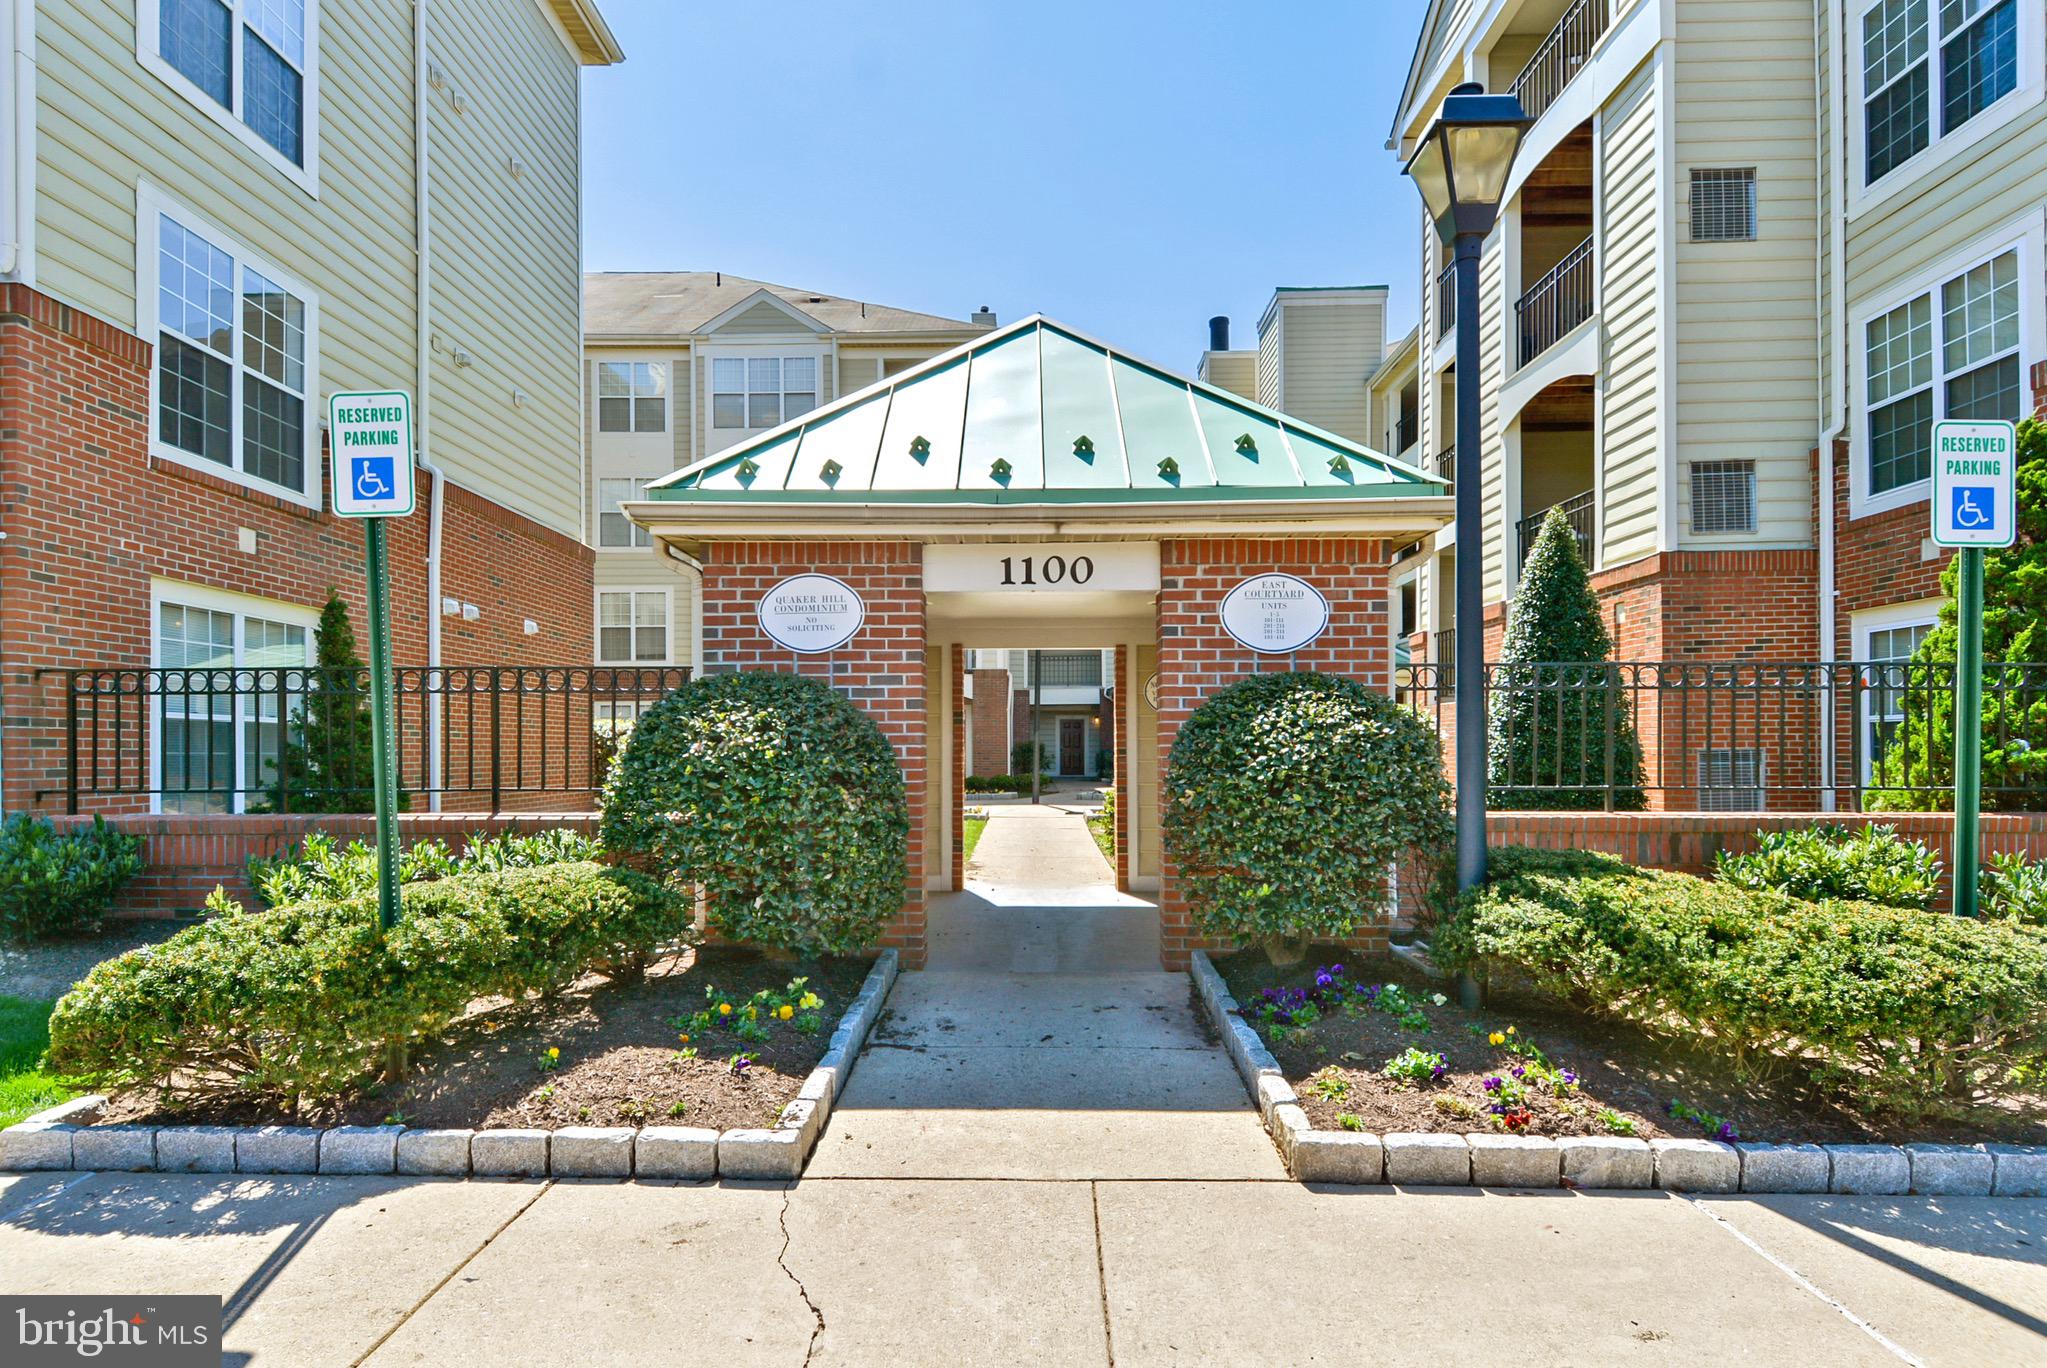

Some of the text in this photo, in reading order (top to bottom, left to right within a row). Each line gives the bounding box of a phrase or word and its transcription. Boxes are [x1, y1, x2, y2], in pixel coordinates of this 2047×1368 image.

[338, 407, 402, 423] RESERVED
[344, 430, 398, 446] PARKING
[1941, 437, 2005, 453] RESERVED
[1946, 460, 2001, 476] PARKING
[1000, 555, 1094, 585] 1100
[1262, 581, 1287, 589] EAST
[775, 595, 846, 604] QUAKER HILL
[1244, 590, 1304, 598] COURTYARD
[774, 604, 848, 612] CONDOMINIUM
[787, 624, 835, 632] SOLICITING
